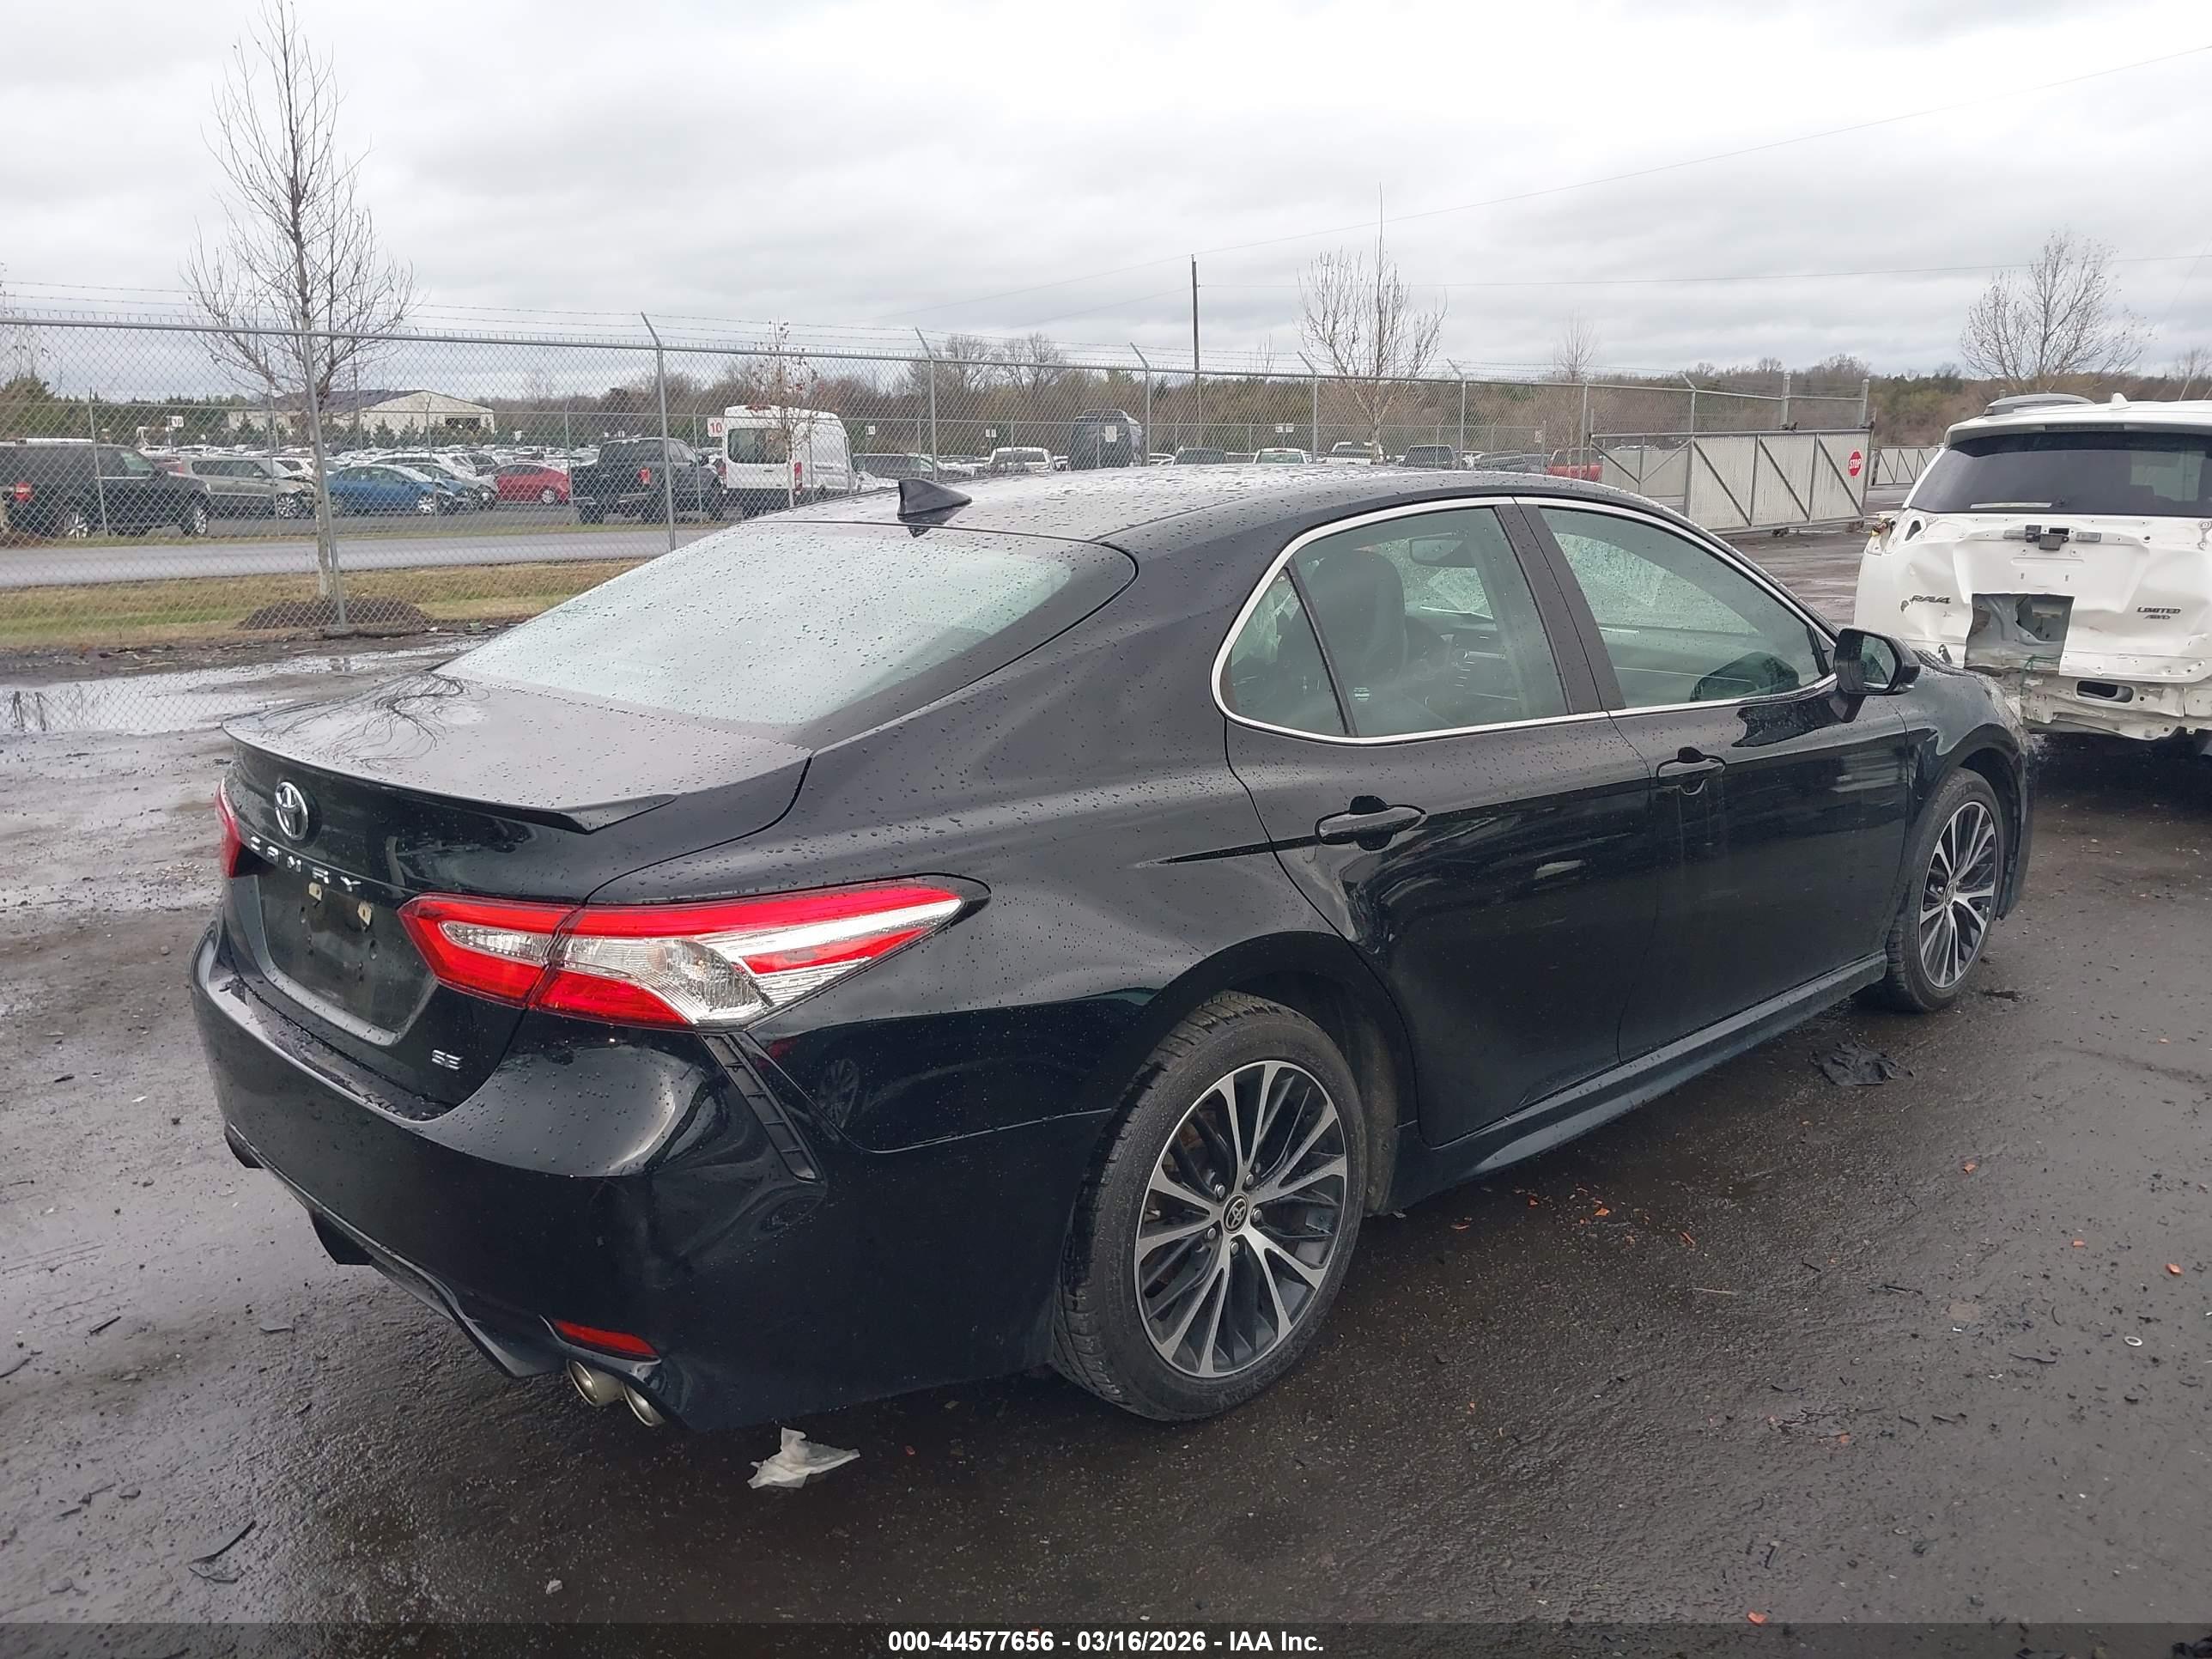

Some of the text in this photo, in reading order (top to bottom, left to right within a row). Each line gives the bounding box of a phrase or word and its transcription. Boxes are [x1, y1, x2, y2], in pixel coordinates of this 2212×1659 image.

[710, 422, 722, 434] 10
[1850, 459, 1862, 470] STOP
[250, 836, 362, 892] CAMRY
[431, 1049, 463, 1070] SE
